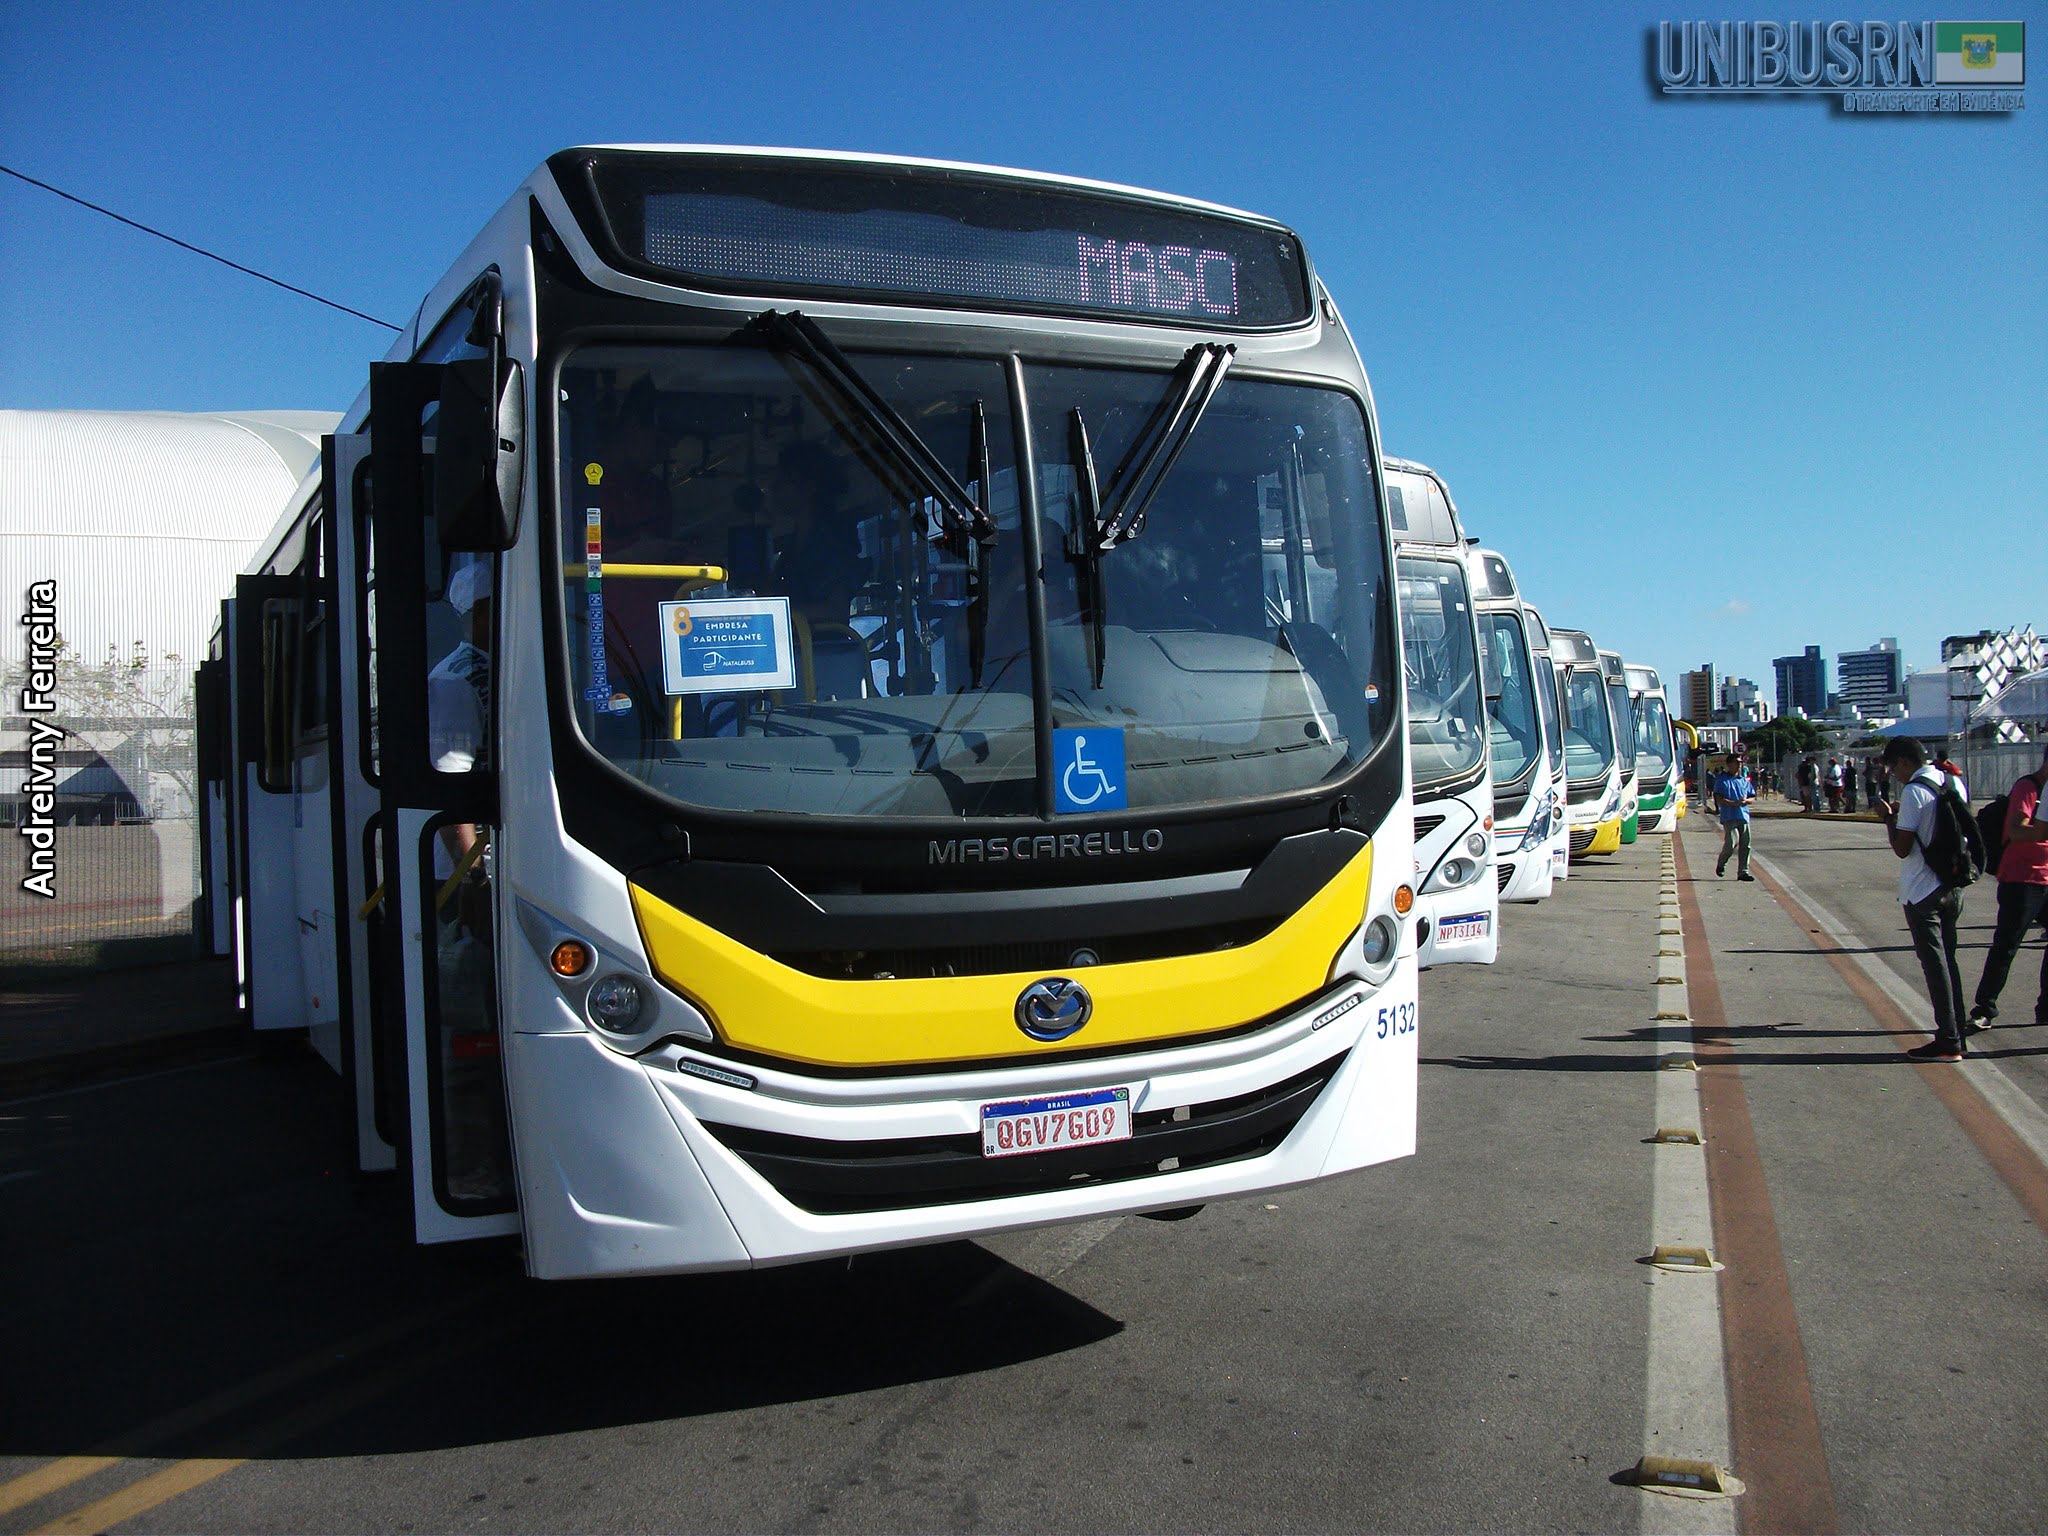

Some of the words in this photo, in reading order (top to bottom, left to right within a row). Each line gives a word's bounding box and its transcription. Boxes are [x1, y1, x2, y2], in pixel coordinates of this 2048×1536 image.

[1078, 236, 1238, 315] MASC
[673, 607, 692, 636] 8
[705, 622, 748, 630] EMPRESA
[693, 633, 762, 643] PARTICIPANTE
[928, 828, 1164, 863] MASCARELLO
[1377, 1001, 1415, 1039] 5132
[1047, 1100, 1071, 1109] BRASIL
[998, 1107, 1115, 1149] QGV7G09
[986, 1145, 996, 1155] BR
